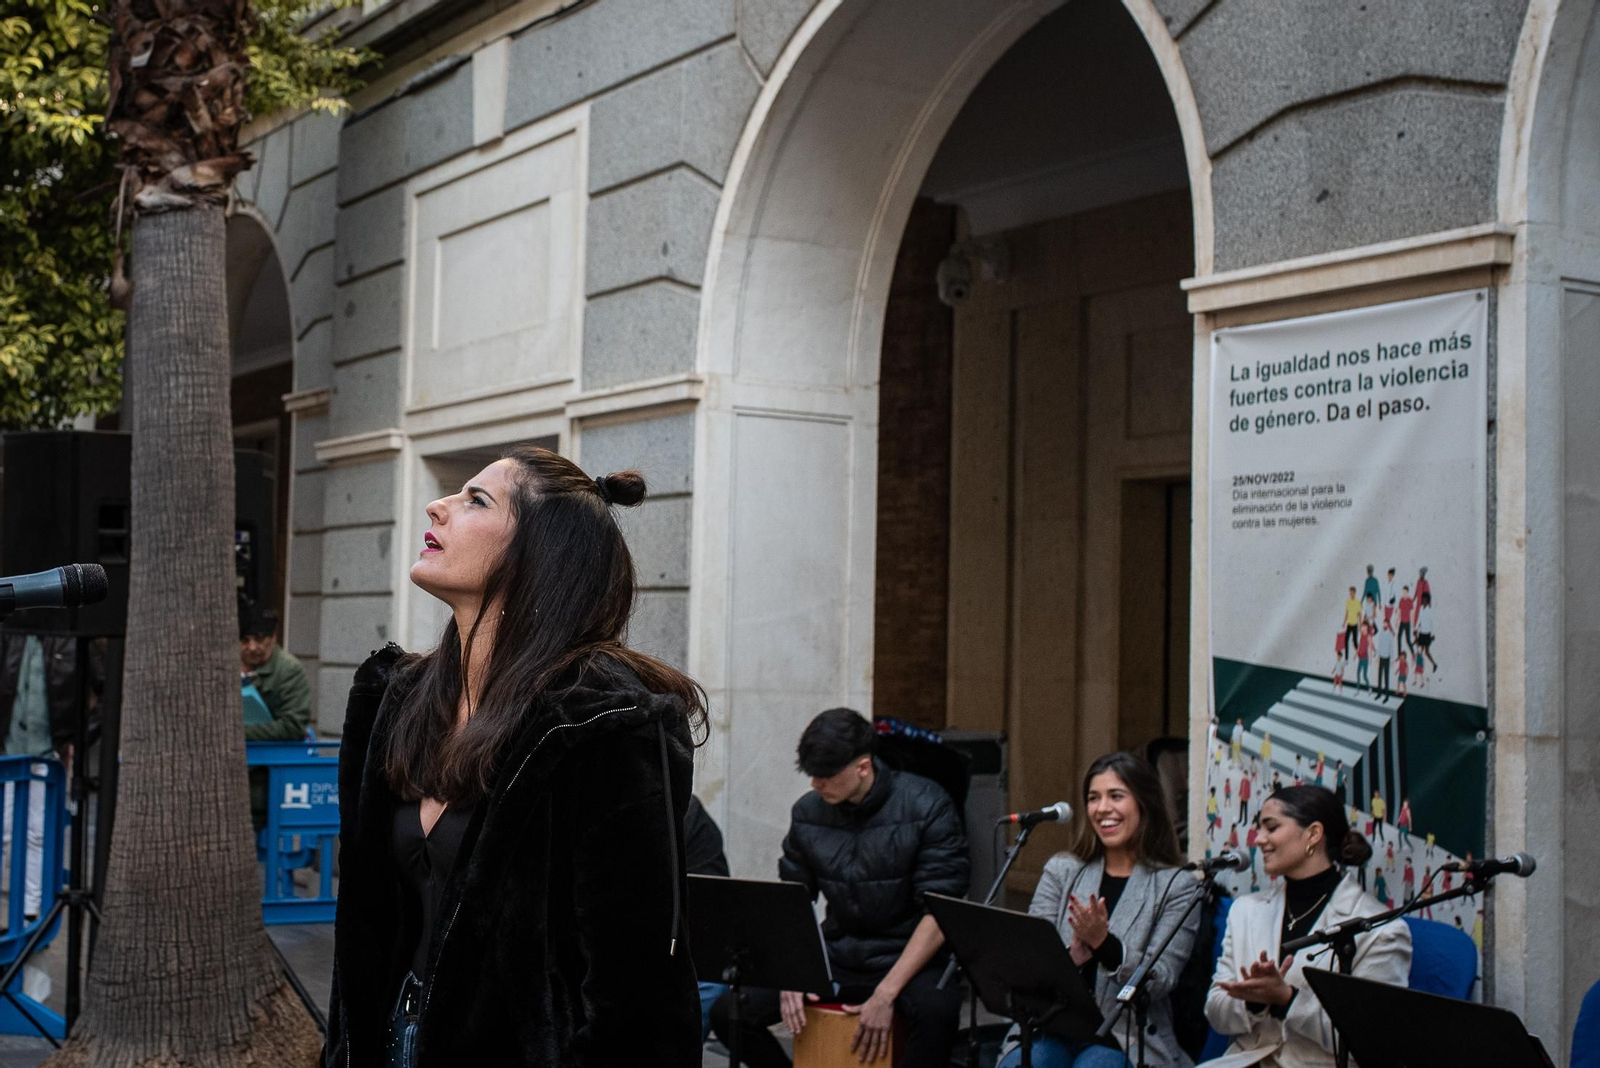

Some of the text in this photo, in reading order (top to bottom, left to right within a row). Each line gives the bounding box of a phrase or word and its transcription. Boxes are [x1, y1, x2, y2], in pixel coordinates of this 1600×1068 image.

[1230, 330, 1472, 382] La igualdad nos hace más
[1230, 359, 1469, 407] fuertes contra la violencia
[1229, 396, 1430, 435] de género. Da el paso.
[1232, 470, 1295, 487] 25/NOV/2022
[1250, 484, 1309, 499] internacional
[1311, 485, 1333, 497] para
[1336, 481, 1346, 494] la
[1232, 498, 1353, 515] eliminación de la violencia
[1232, 515, 1319, 530] contra las mujeres.
